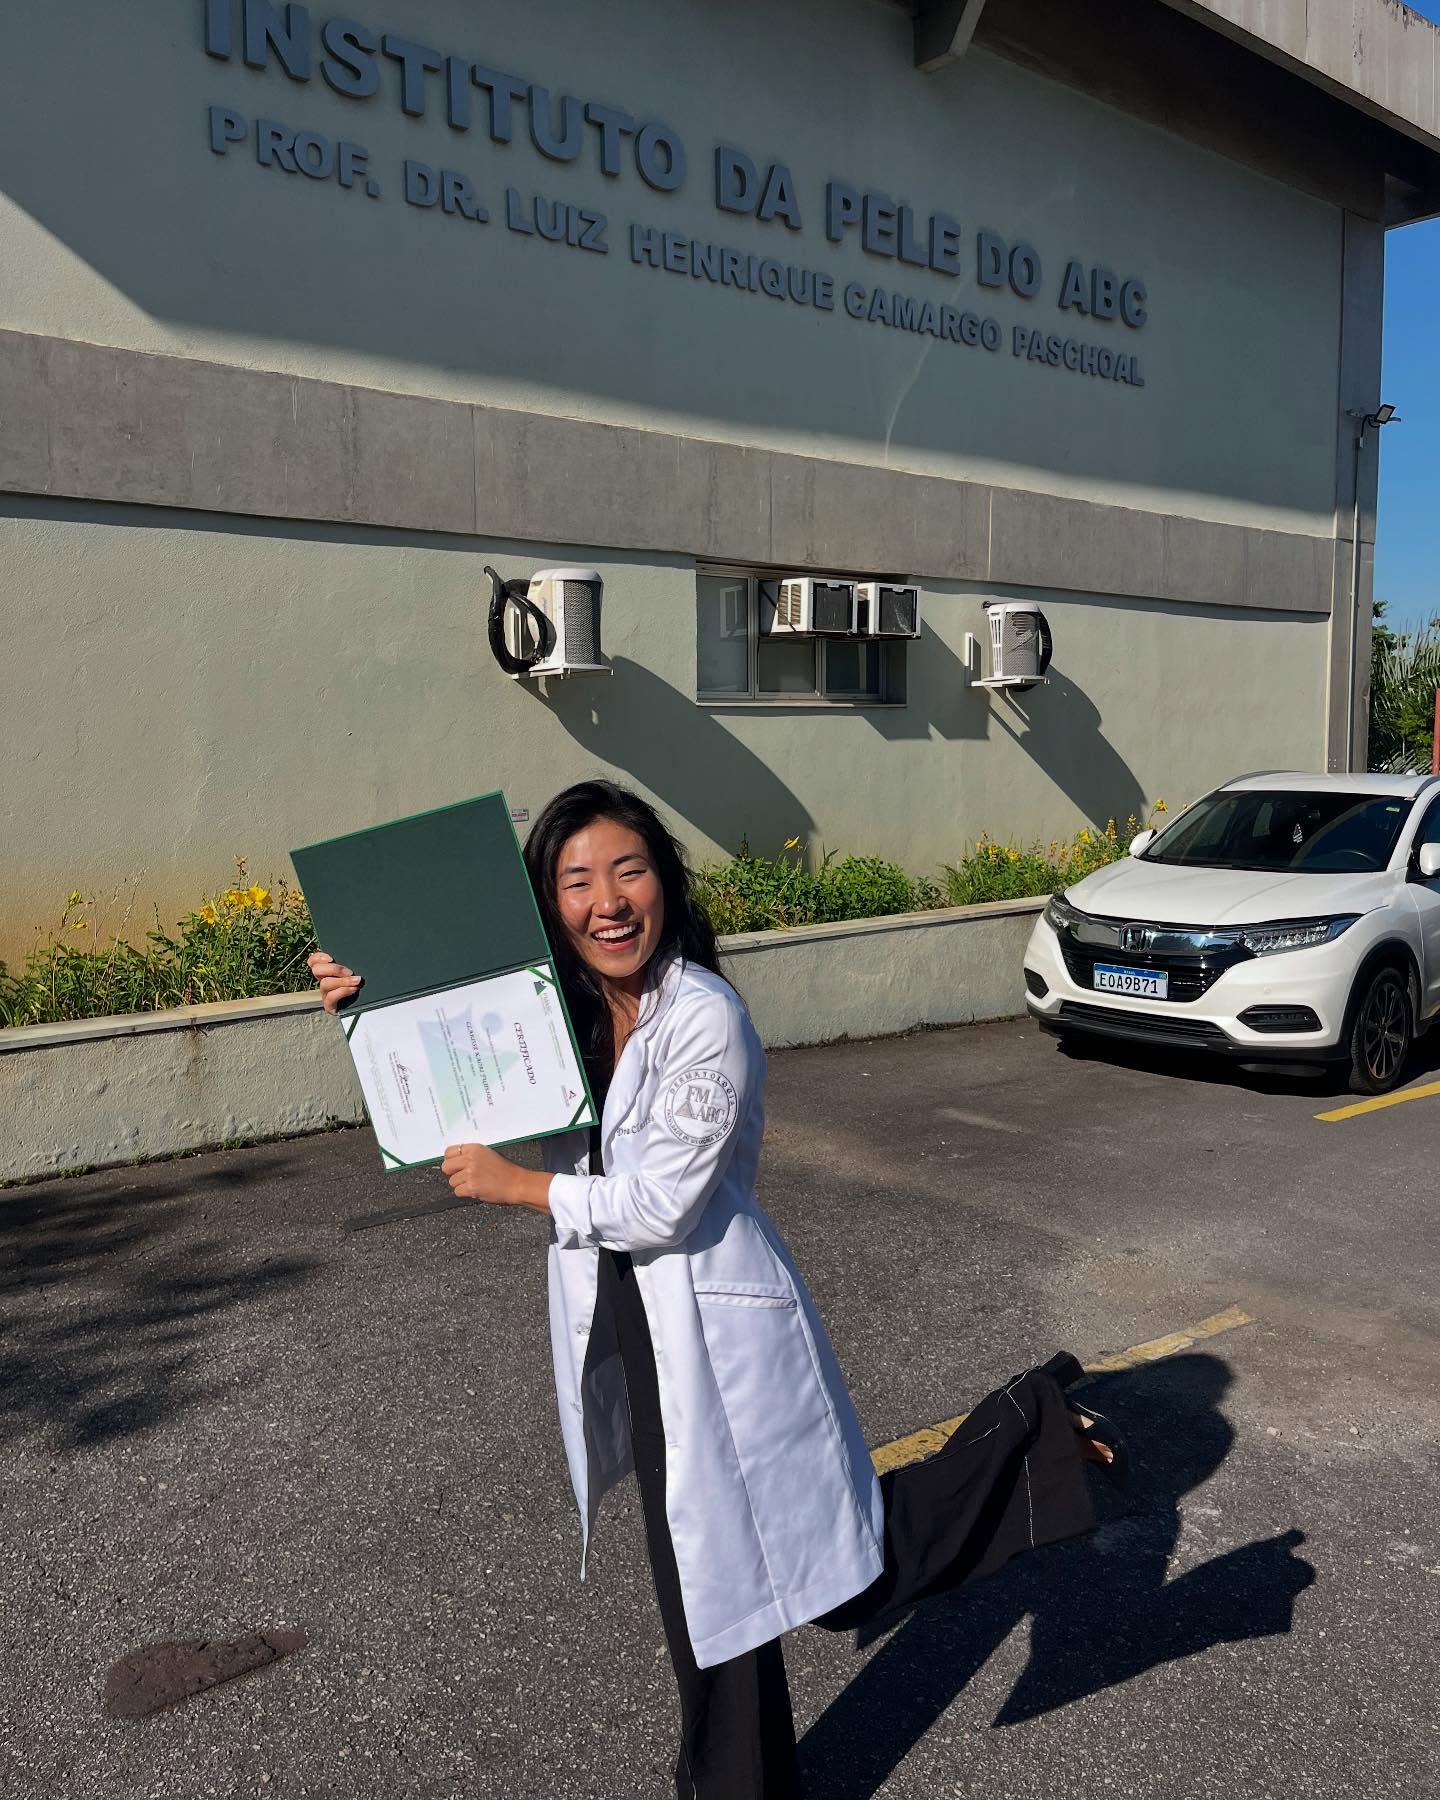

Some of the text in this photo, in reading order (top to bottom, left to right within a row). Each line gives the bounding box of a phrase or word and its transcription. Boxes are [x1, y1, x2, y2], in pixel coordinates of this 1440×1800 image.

[206, 0, 1149, 328] INSTITUTO DA PELE DO ABC
[209, 106, 1146, 387] PROF. DR. LUIZ HENRIQUE CAMARGO PASCHOAL
[513, 1022, 537, 1086] CERTIFICADO
[697, 1105, 726, 1125] ABC
